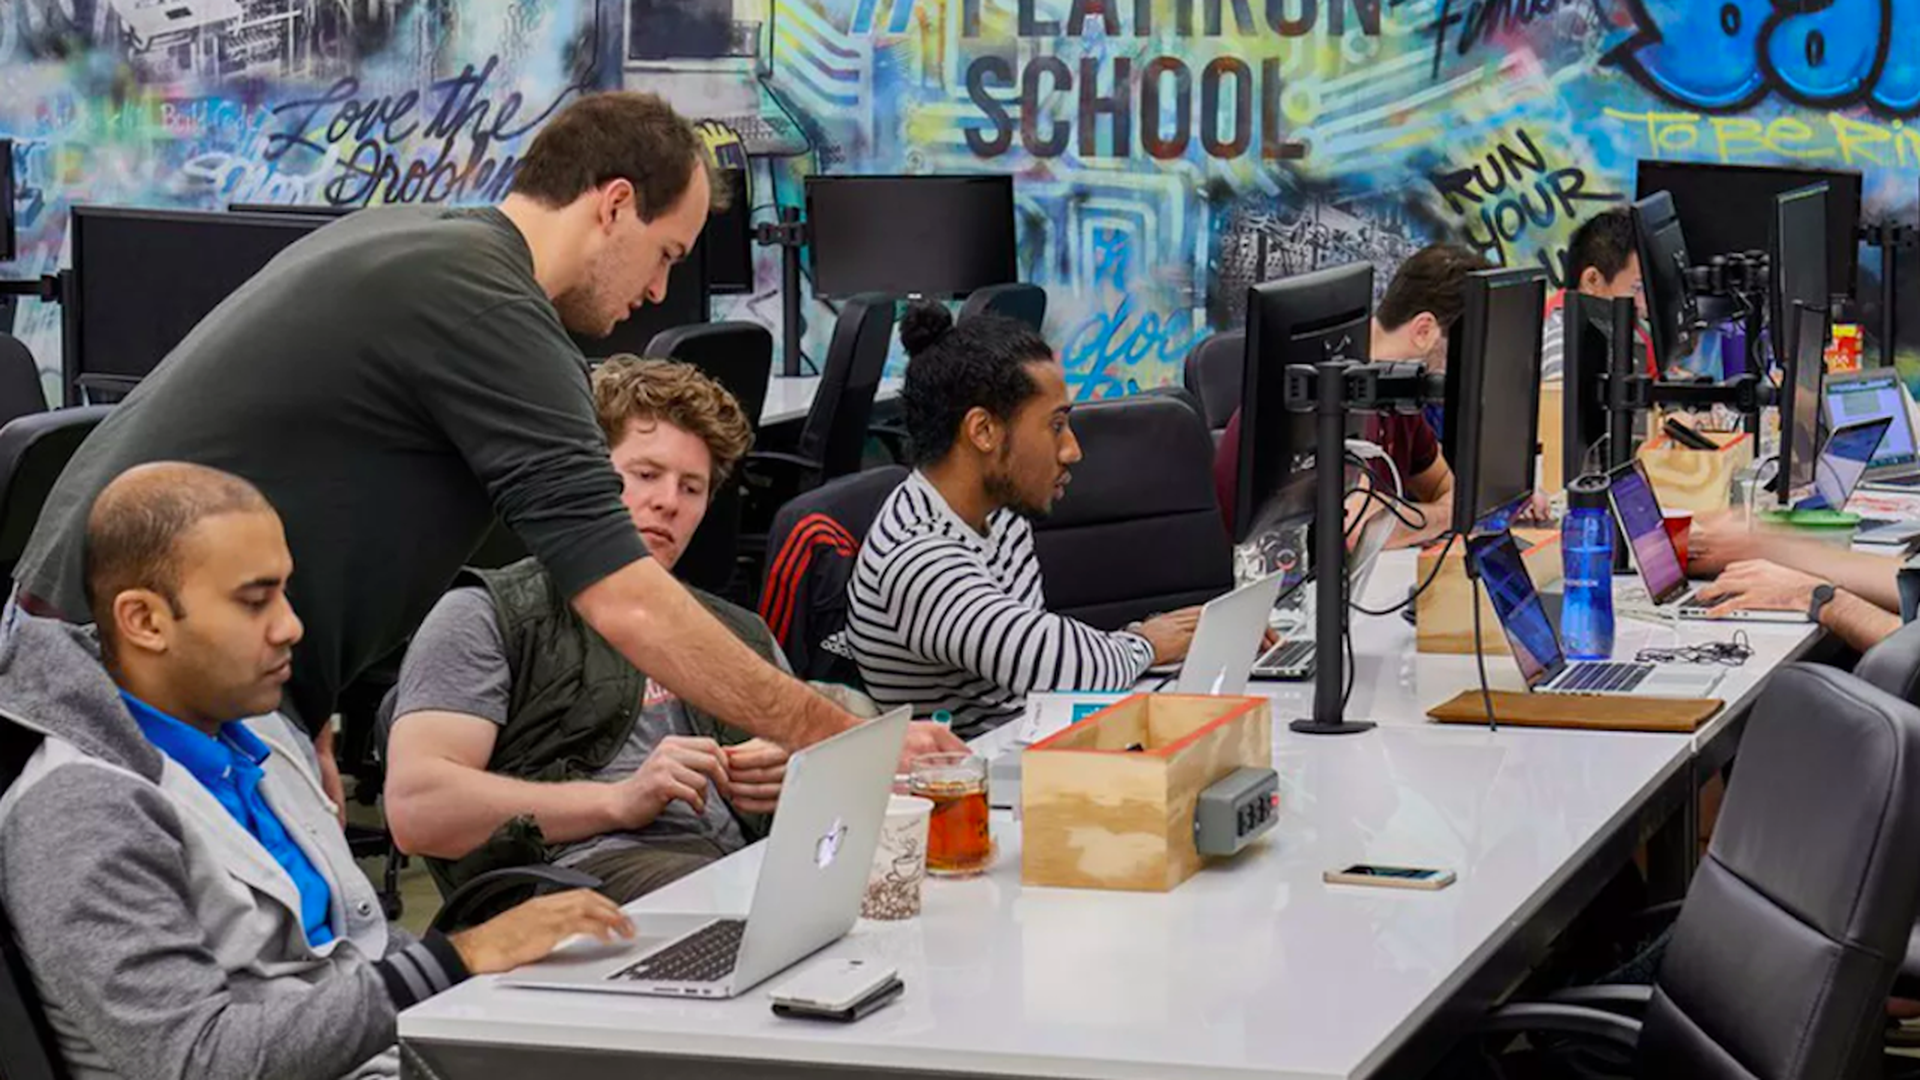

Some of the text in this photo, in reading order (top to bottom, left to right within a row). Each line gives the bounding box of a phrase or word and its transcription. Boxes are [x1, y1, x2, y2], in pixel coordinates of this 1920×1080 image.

[262, 54, 562, 161] Love the
[964, 55, 1306, 160] SCHOOL
[1432, 128, 1547, 215] RUN
